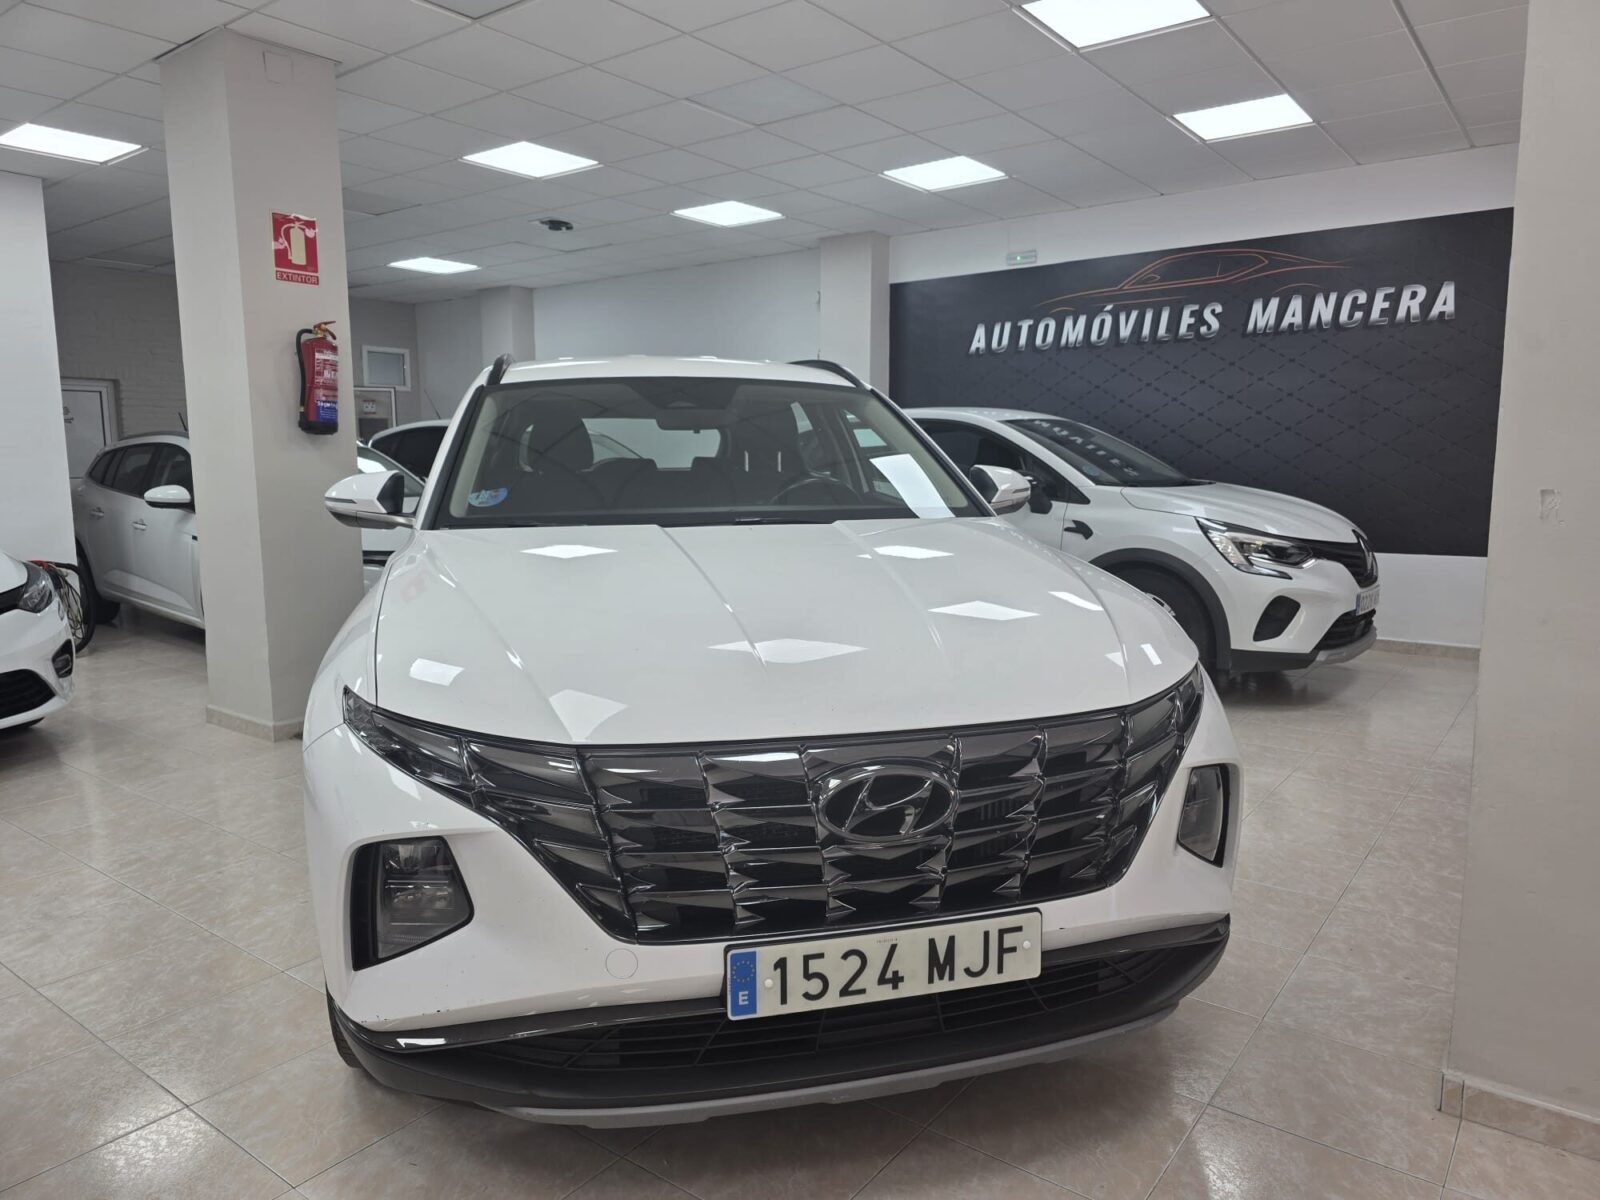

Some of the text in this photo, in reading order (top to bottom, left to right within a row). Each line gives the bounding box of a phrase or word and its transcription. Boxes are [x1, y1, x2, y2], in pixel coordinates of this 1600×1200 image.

[277, 271, 318, 284] EXTINTOR
[968, 281, 1456, 355] AUTOMÓVILES MANCERA
[773, 925, 1023, 1006] 1524 MJF
[738, 991, 749, 1006] E
